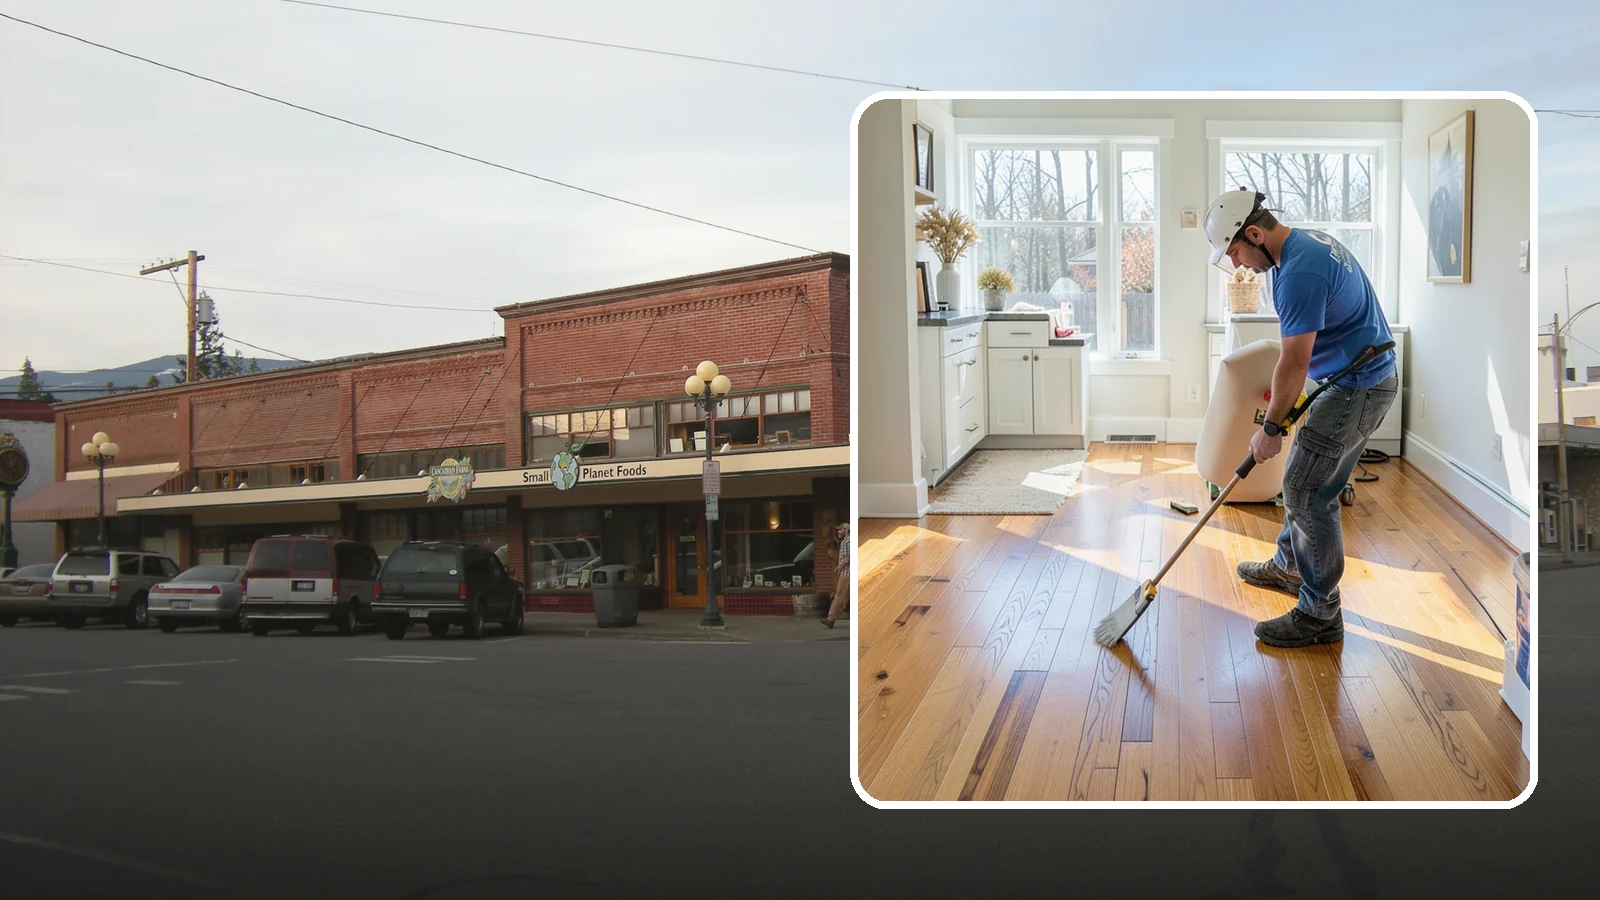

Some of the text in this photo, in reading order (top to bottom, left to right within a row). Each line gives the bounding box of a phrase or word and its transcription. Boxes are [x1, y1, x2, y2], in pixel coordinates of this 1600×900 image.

[523, 464, 647, 483] Small Planet Foods
